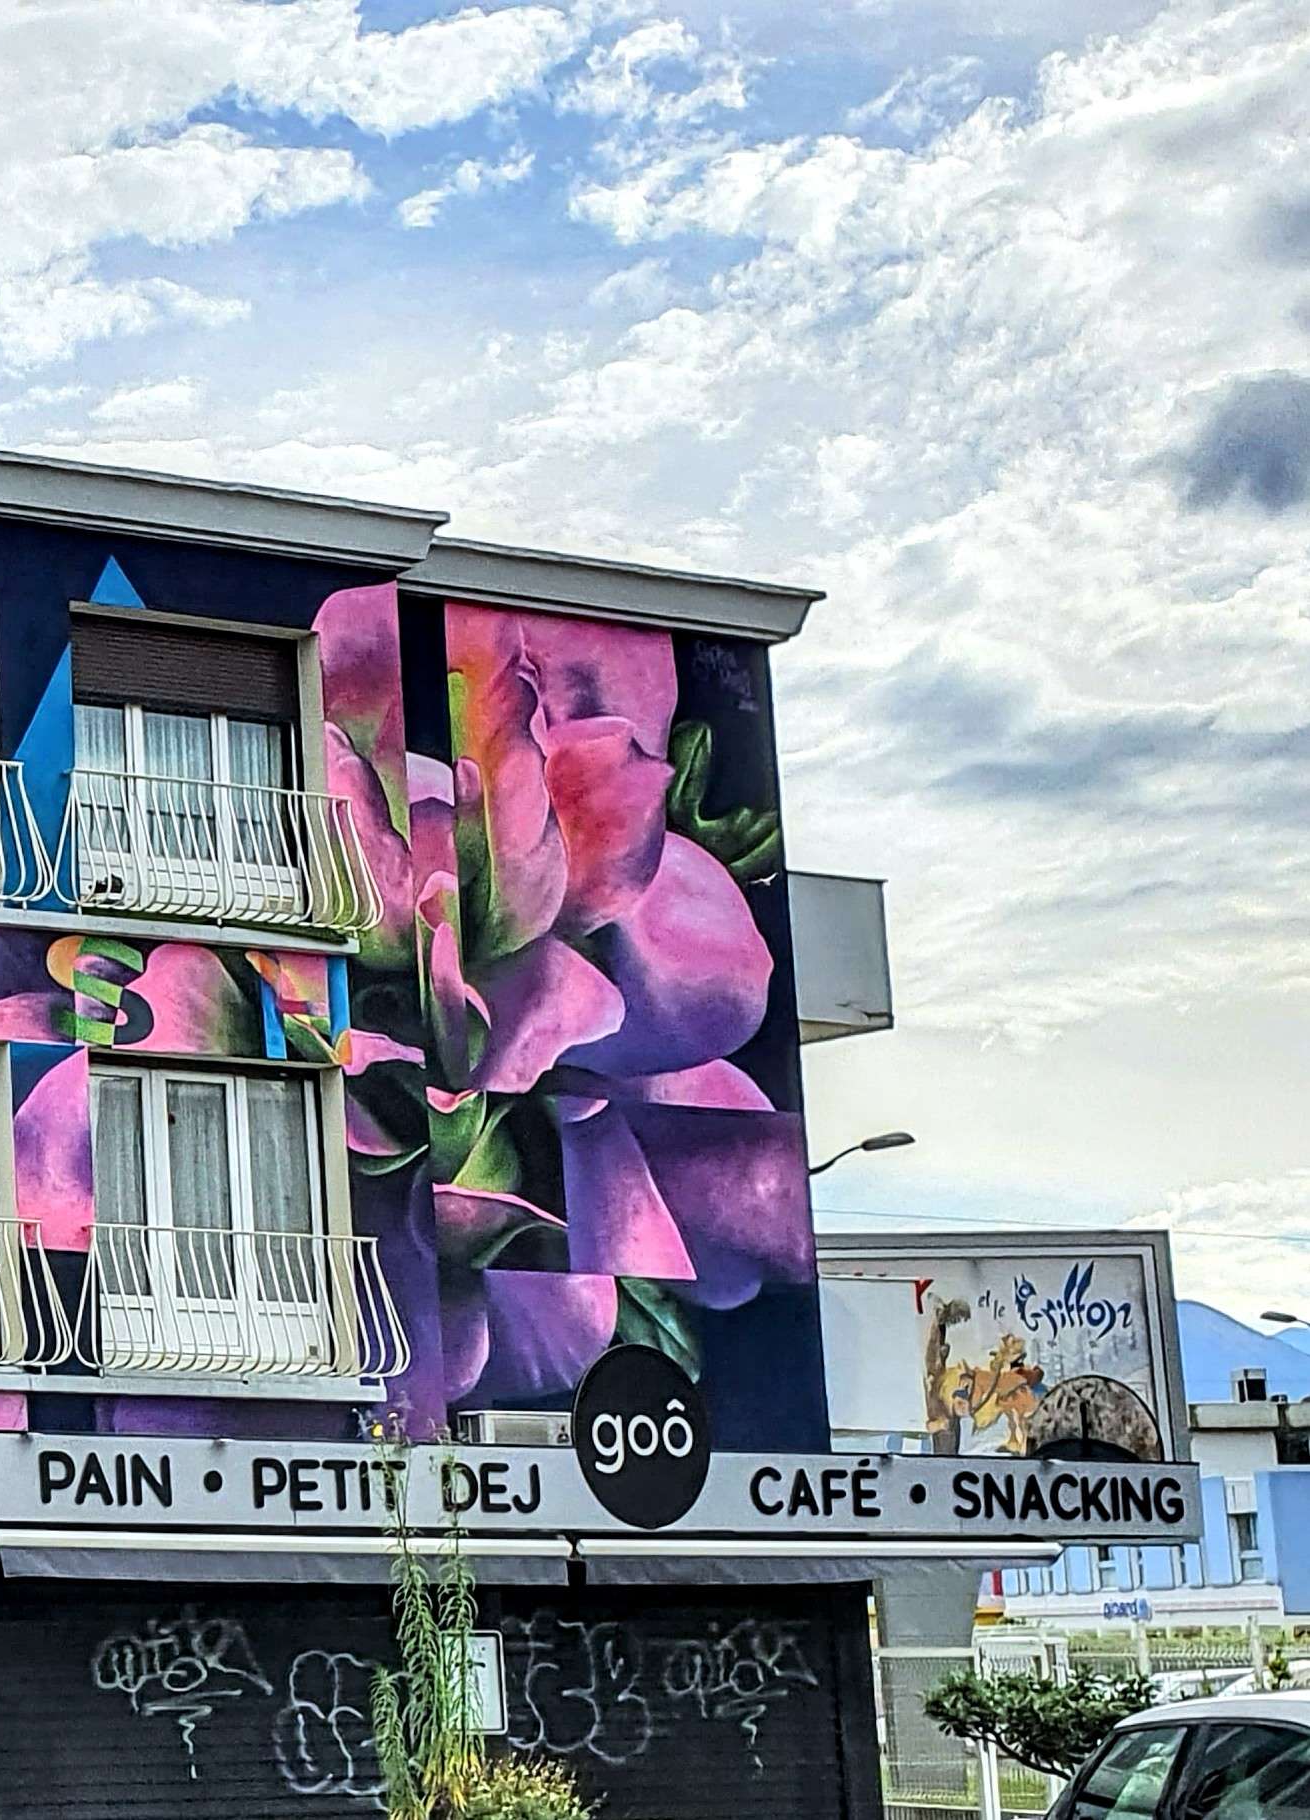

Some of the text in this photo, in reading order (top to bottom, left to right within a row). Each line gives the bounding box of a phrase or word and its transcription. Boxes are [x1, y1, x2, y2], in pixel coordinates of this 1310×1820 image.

[590, 1397, 694, 1474] goô
[39, 1450, 542, 1514] PAIN PETIT DEJ
[749, 1459, 1185, 1525] CAFÉ SNACKING
